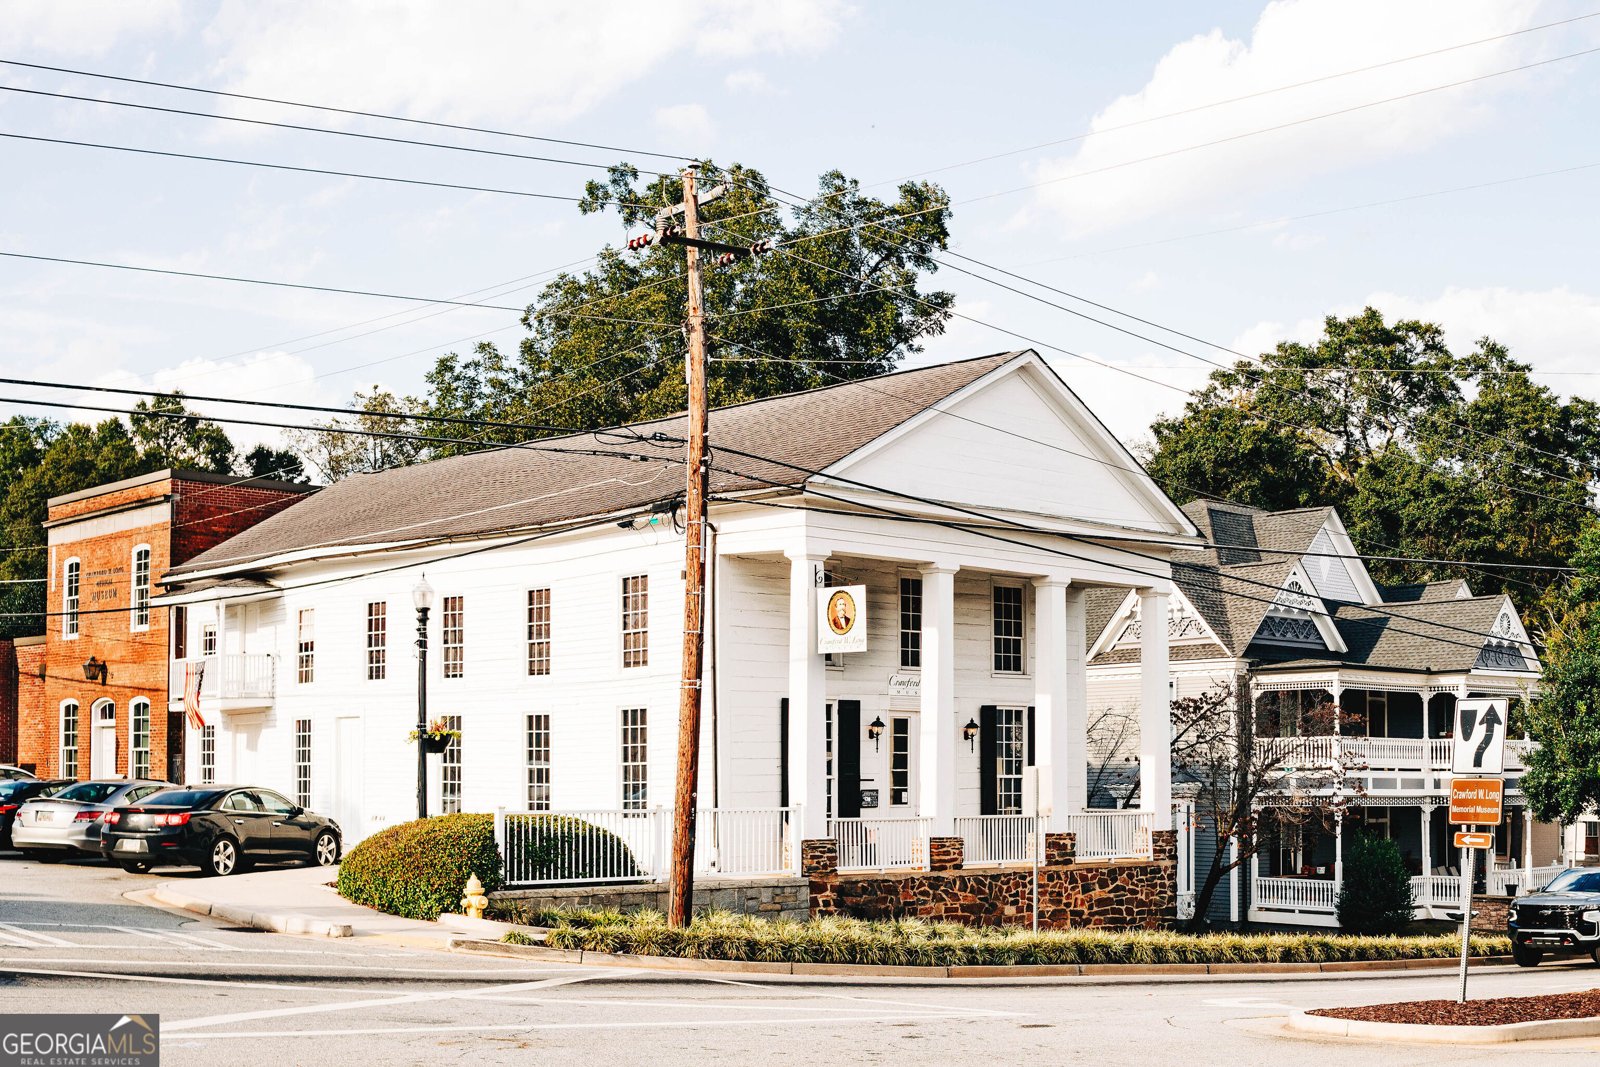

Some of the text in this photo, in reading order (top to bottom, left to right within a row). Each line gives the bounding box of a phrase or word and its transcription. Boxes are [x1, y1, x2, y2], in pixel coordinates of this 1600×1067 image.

[92, 588, 117, 601] MUSEUM
[1453, 788, 1477, 799] Crawford
[1486, 789, 1499, 803] Long
[1452, 805, 1499, 813] Memorial Museum
